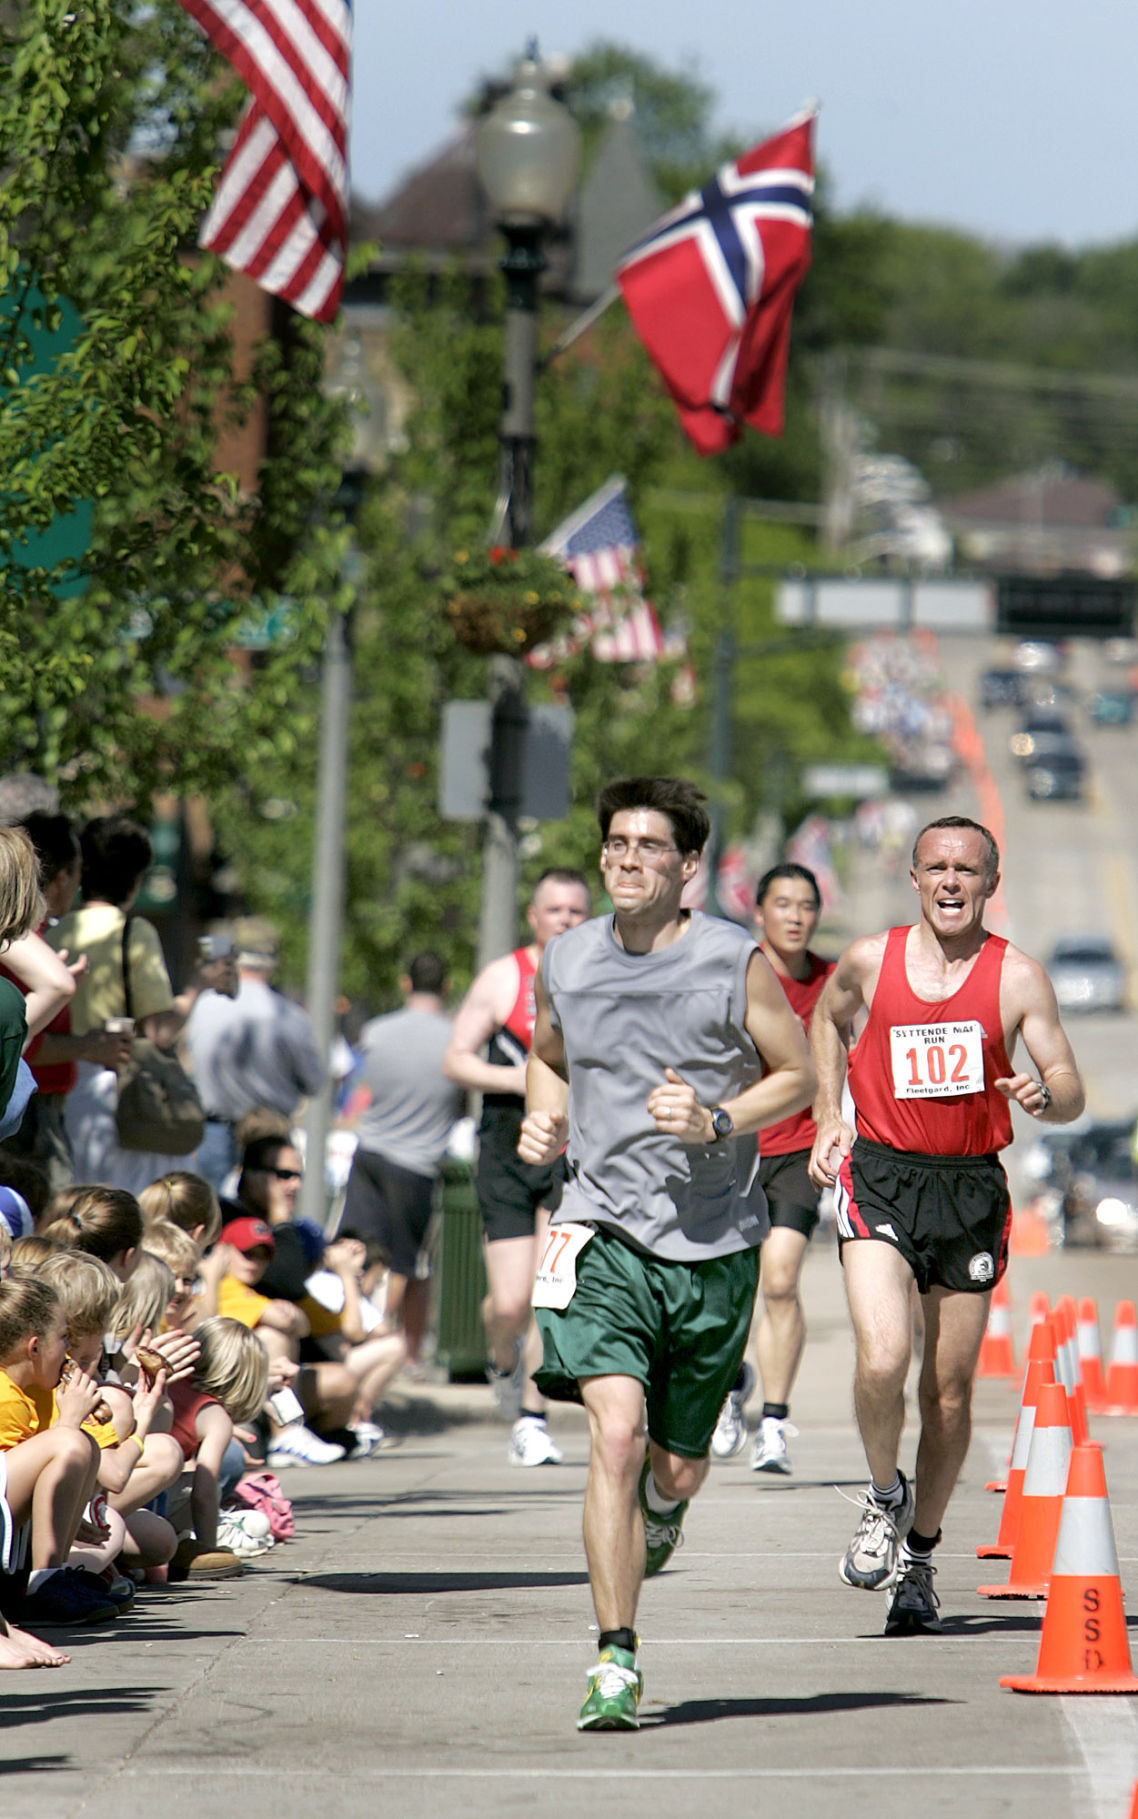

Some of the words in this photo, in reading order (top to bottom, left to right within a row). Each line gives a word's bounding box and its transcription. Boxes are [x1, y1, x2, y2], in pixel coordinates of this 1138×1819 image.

[895, 1027, 949, 1038] SYTTENDE
[953, 1025, 974, 1034] MAI
[924, 1036, 945, 1045] RUN
[905, 1044, 970, 1086] 102
